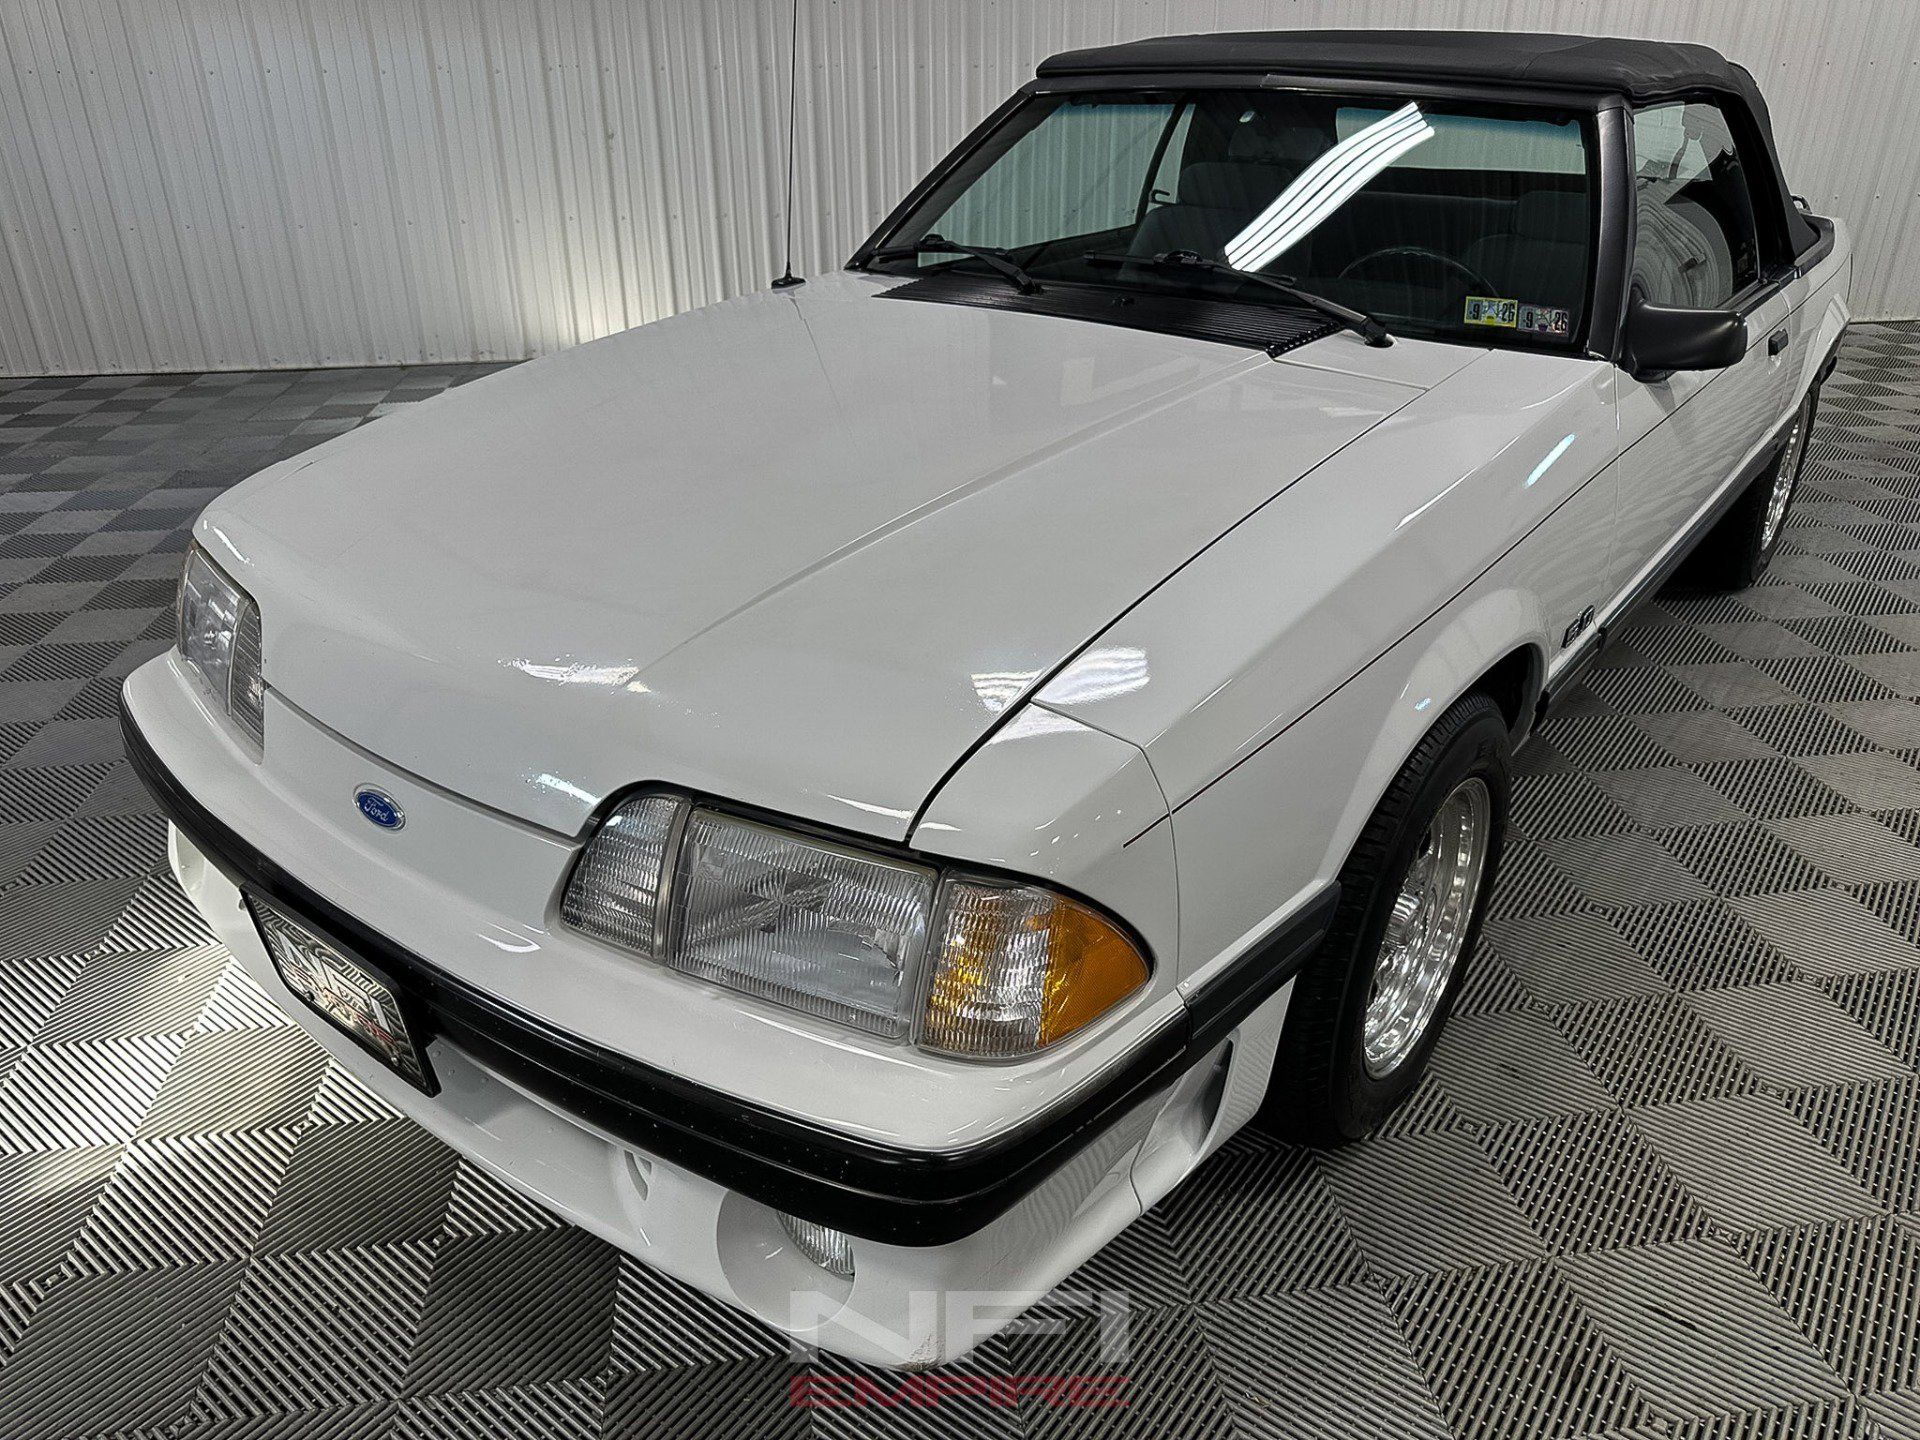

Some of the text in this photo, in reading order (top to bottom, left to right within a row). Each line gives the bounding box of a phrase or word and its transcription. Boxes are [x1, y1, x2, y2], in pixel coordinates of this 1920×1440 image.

[1473, 303, 1515, 321] 9 26
[1526, 311, 1567, 331] 9 26
[364, 797, 390, 821] Ford
